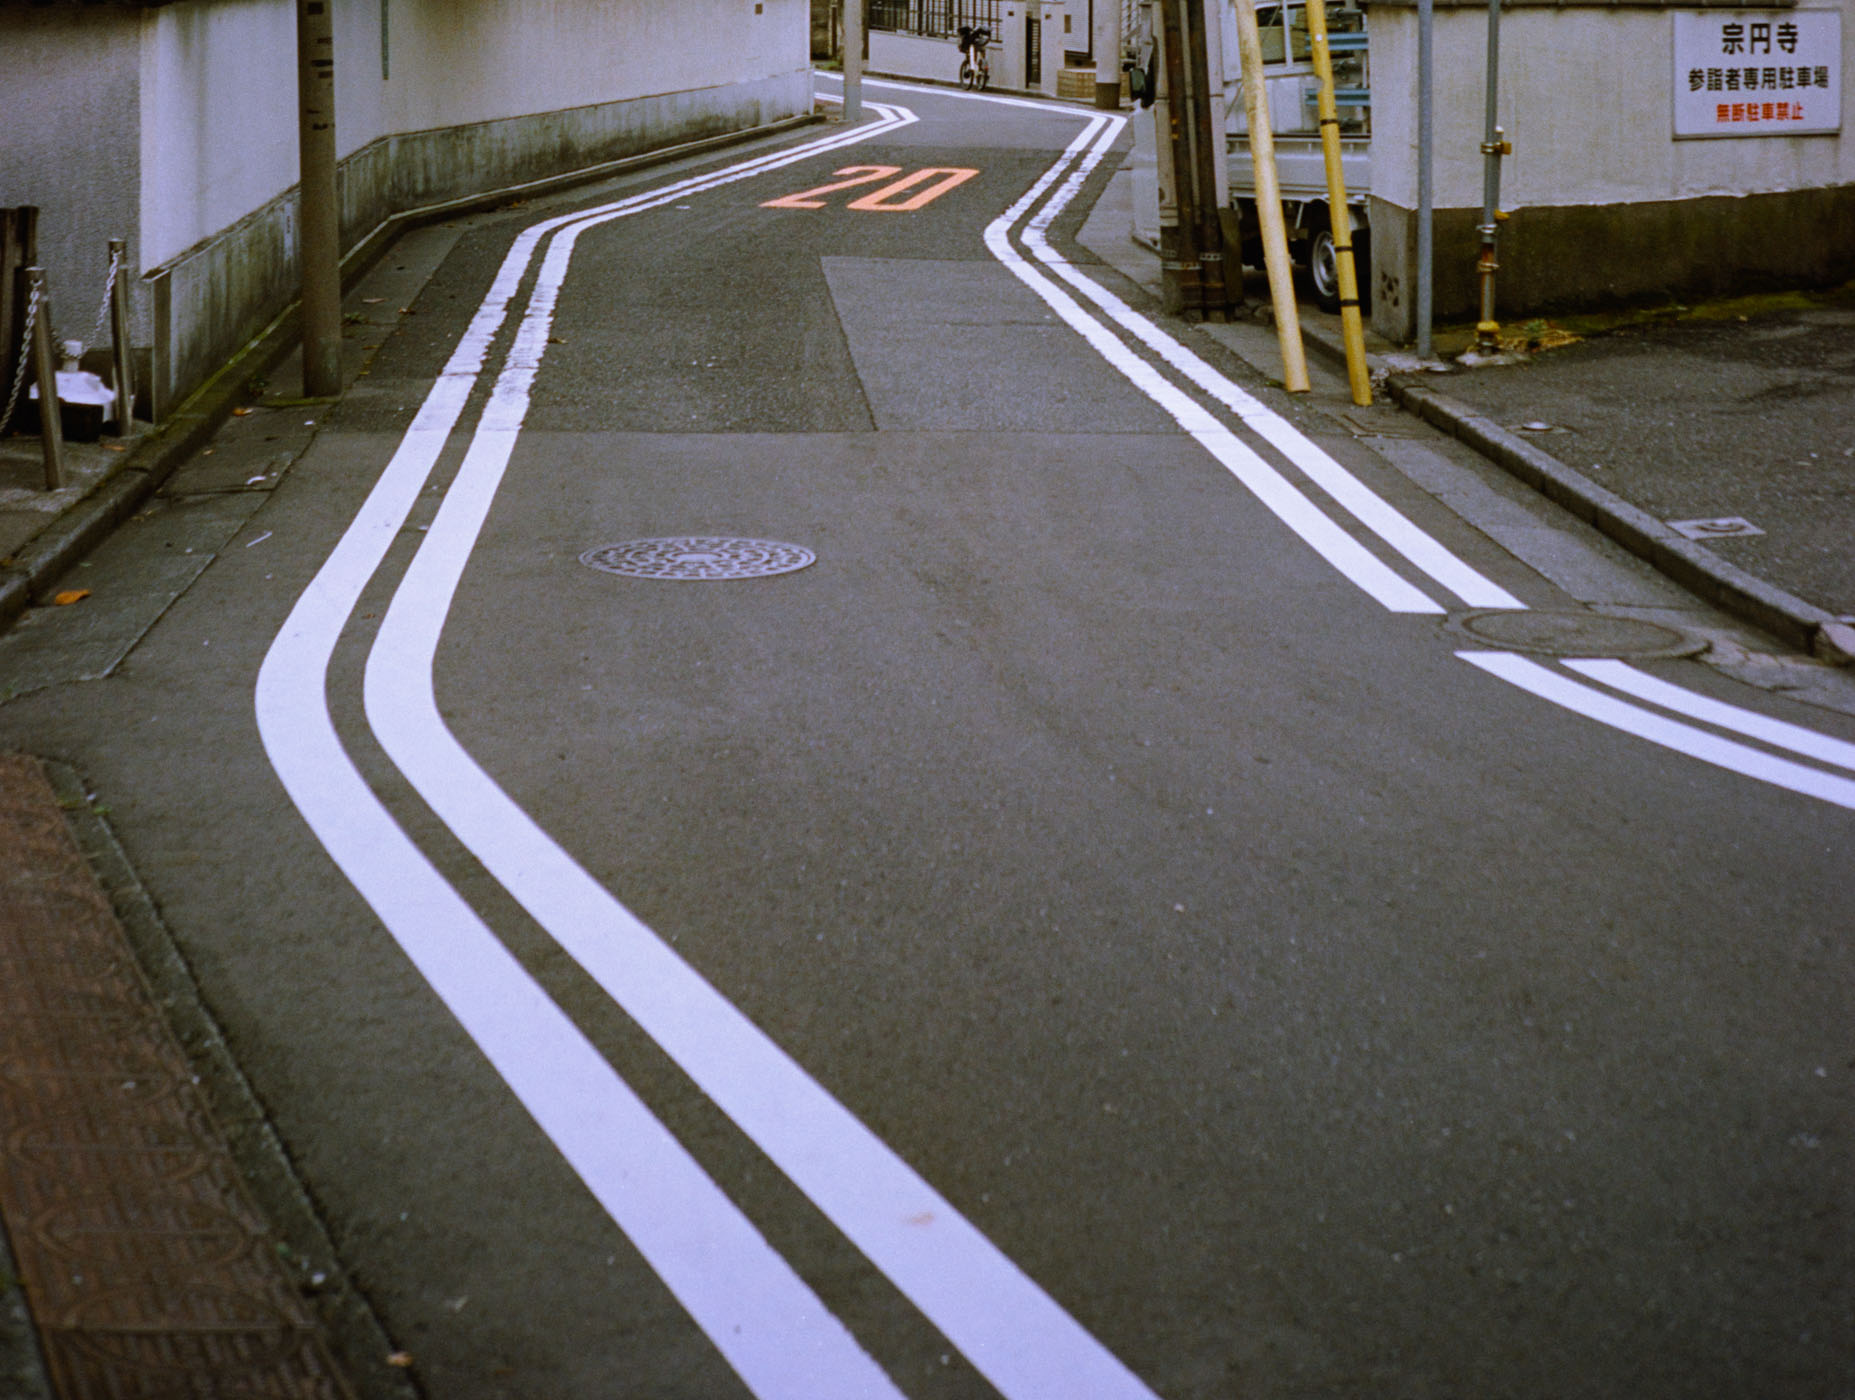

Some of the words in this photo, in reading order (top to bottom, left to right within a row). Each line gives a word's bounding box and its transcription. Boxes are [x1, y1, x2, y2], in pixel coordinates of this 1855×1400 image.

[1722, 22, 1798, 55] 宗円寺
[1689, 66, 1829, 91] 参詣者専用駐車場
[1716, 101, 1804, 123] 無断駐車禁止
[758, 165, 980, 211] 20
